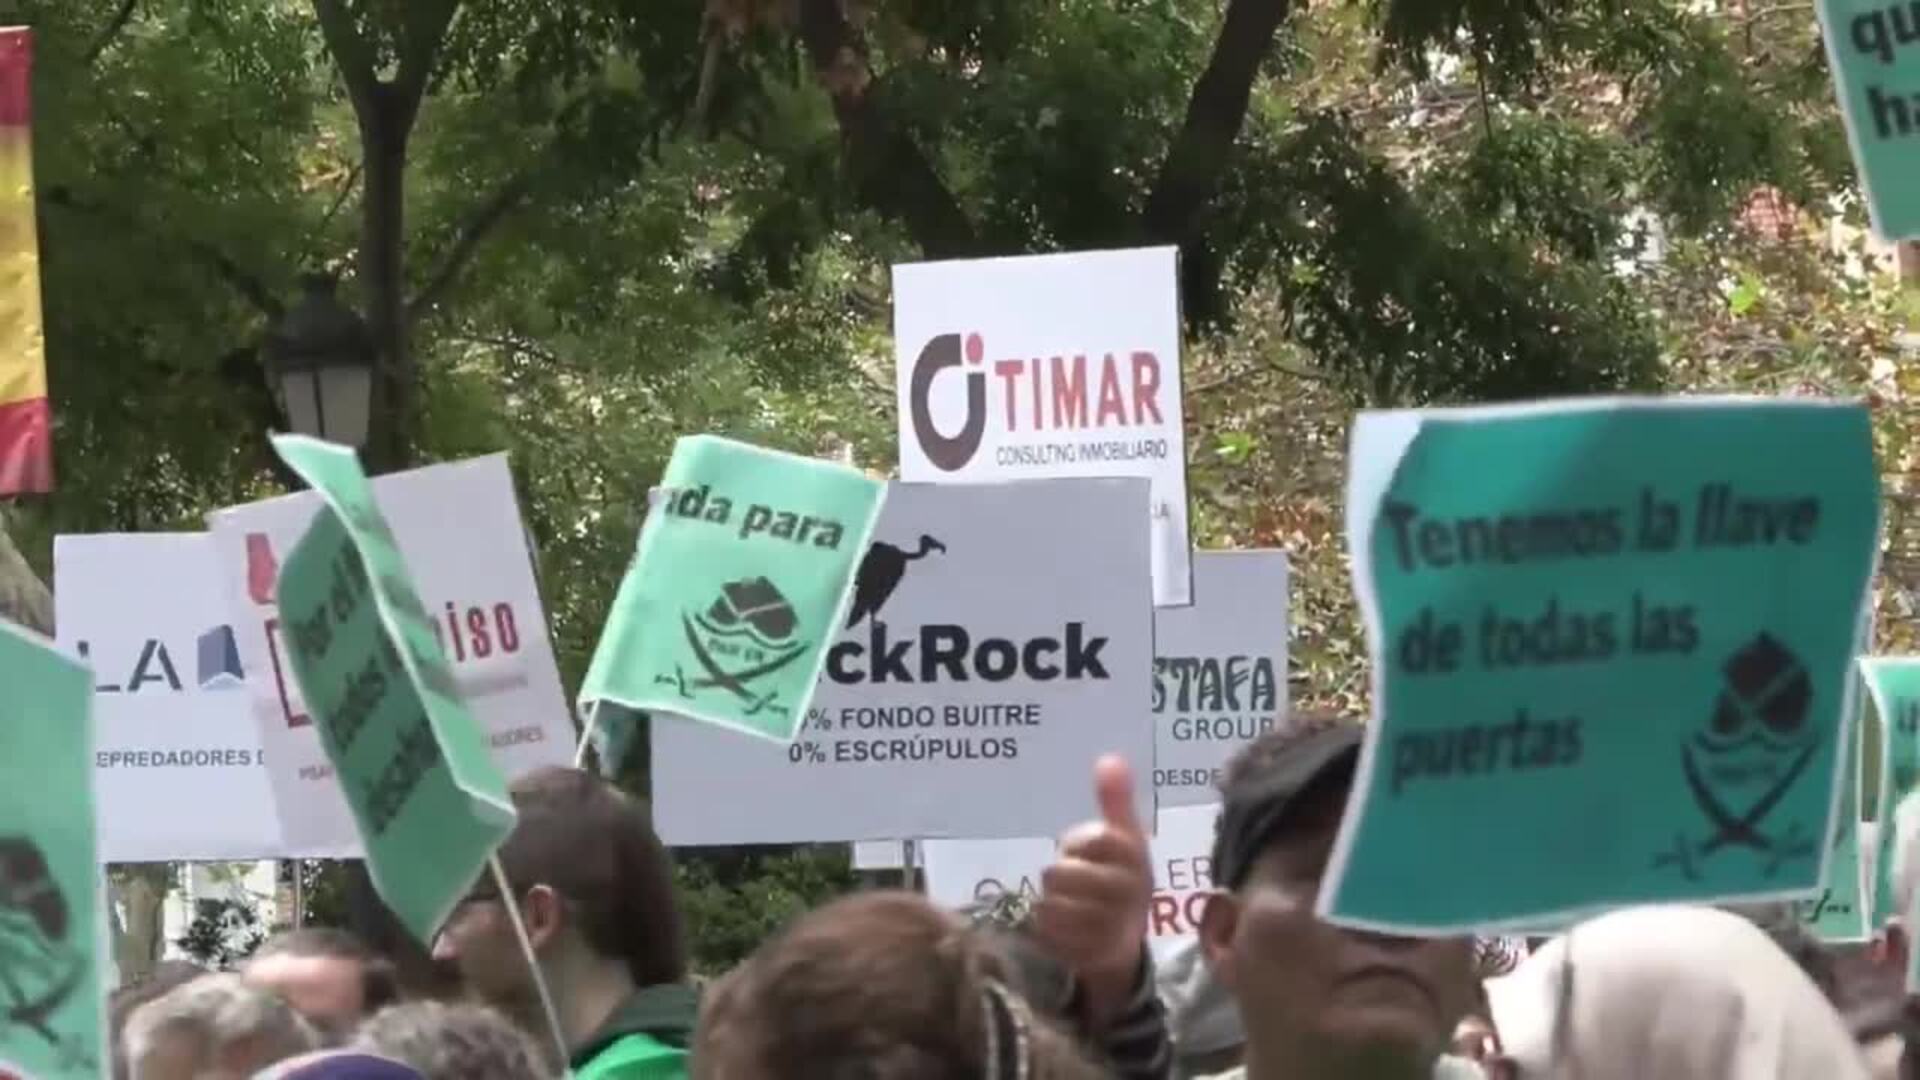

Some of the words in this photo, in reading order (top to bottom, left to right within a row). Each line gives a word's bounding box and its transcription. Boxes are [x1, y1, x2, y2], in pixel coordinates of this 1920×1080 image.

[1866, 85, 1920, 139] h
[996, 445, 1076, 467] CONSULTING
[1079, 438, 1168, 463] INMOBILIARIO
[738, 503, 845, 550] para
[1383, 496, 1624, 572] Tenemos
[1636, 486, 1681, 552] la
[1695, 482, 1819, 549] llave
[433, 601, 520, 662] iso
[820, 621, 1111, 685] ckRock
[1400, 605, 1460, 675] de
[1477, 593, 1616, 670] todas
[1633, 589, 1698, 657] las
[840, 706, 936, 730] FONDO
[943, 703, 1042, 728] BUITRE
[788, 742, 827, 765] 0%
[834, 732, 1019, 763] ESCRÚPULOS
[1390, 707, 1582, 796] puertas
